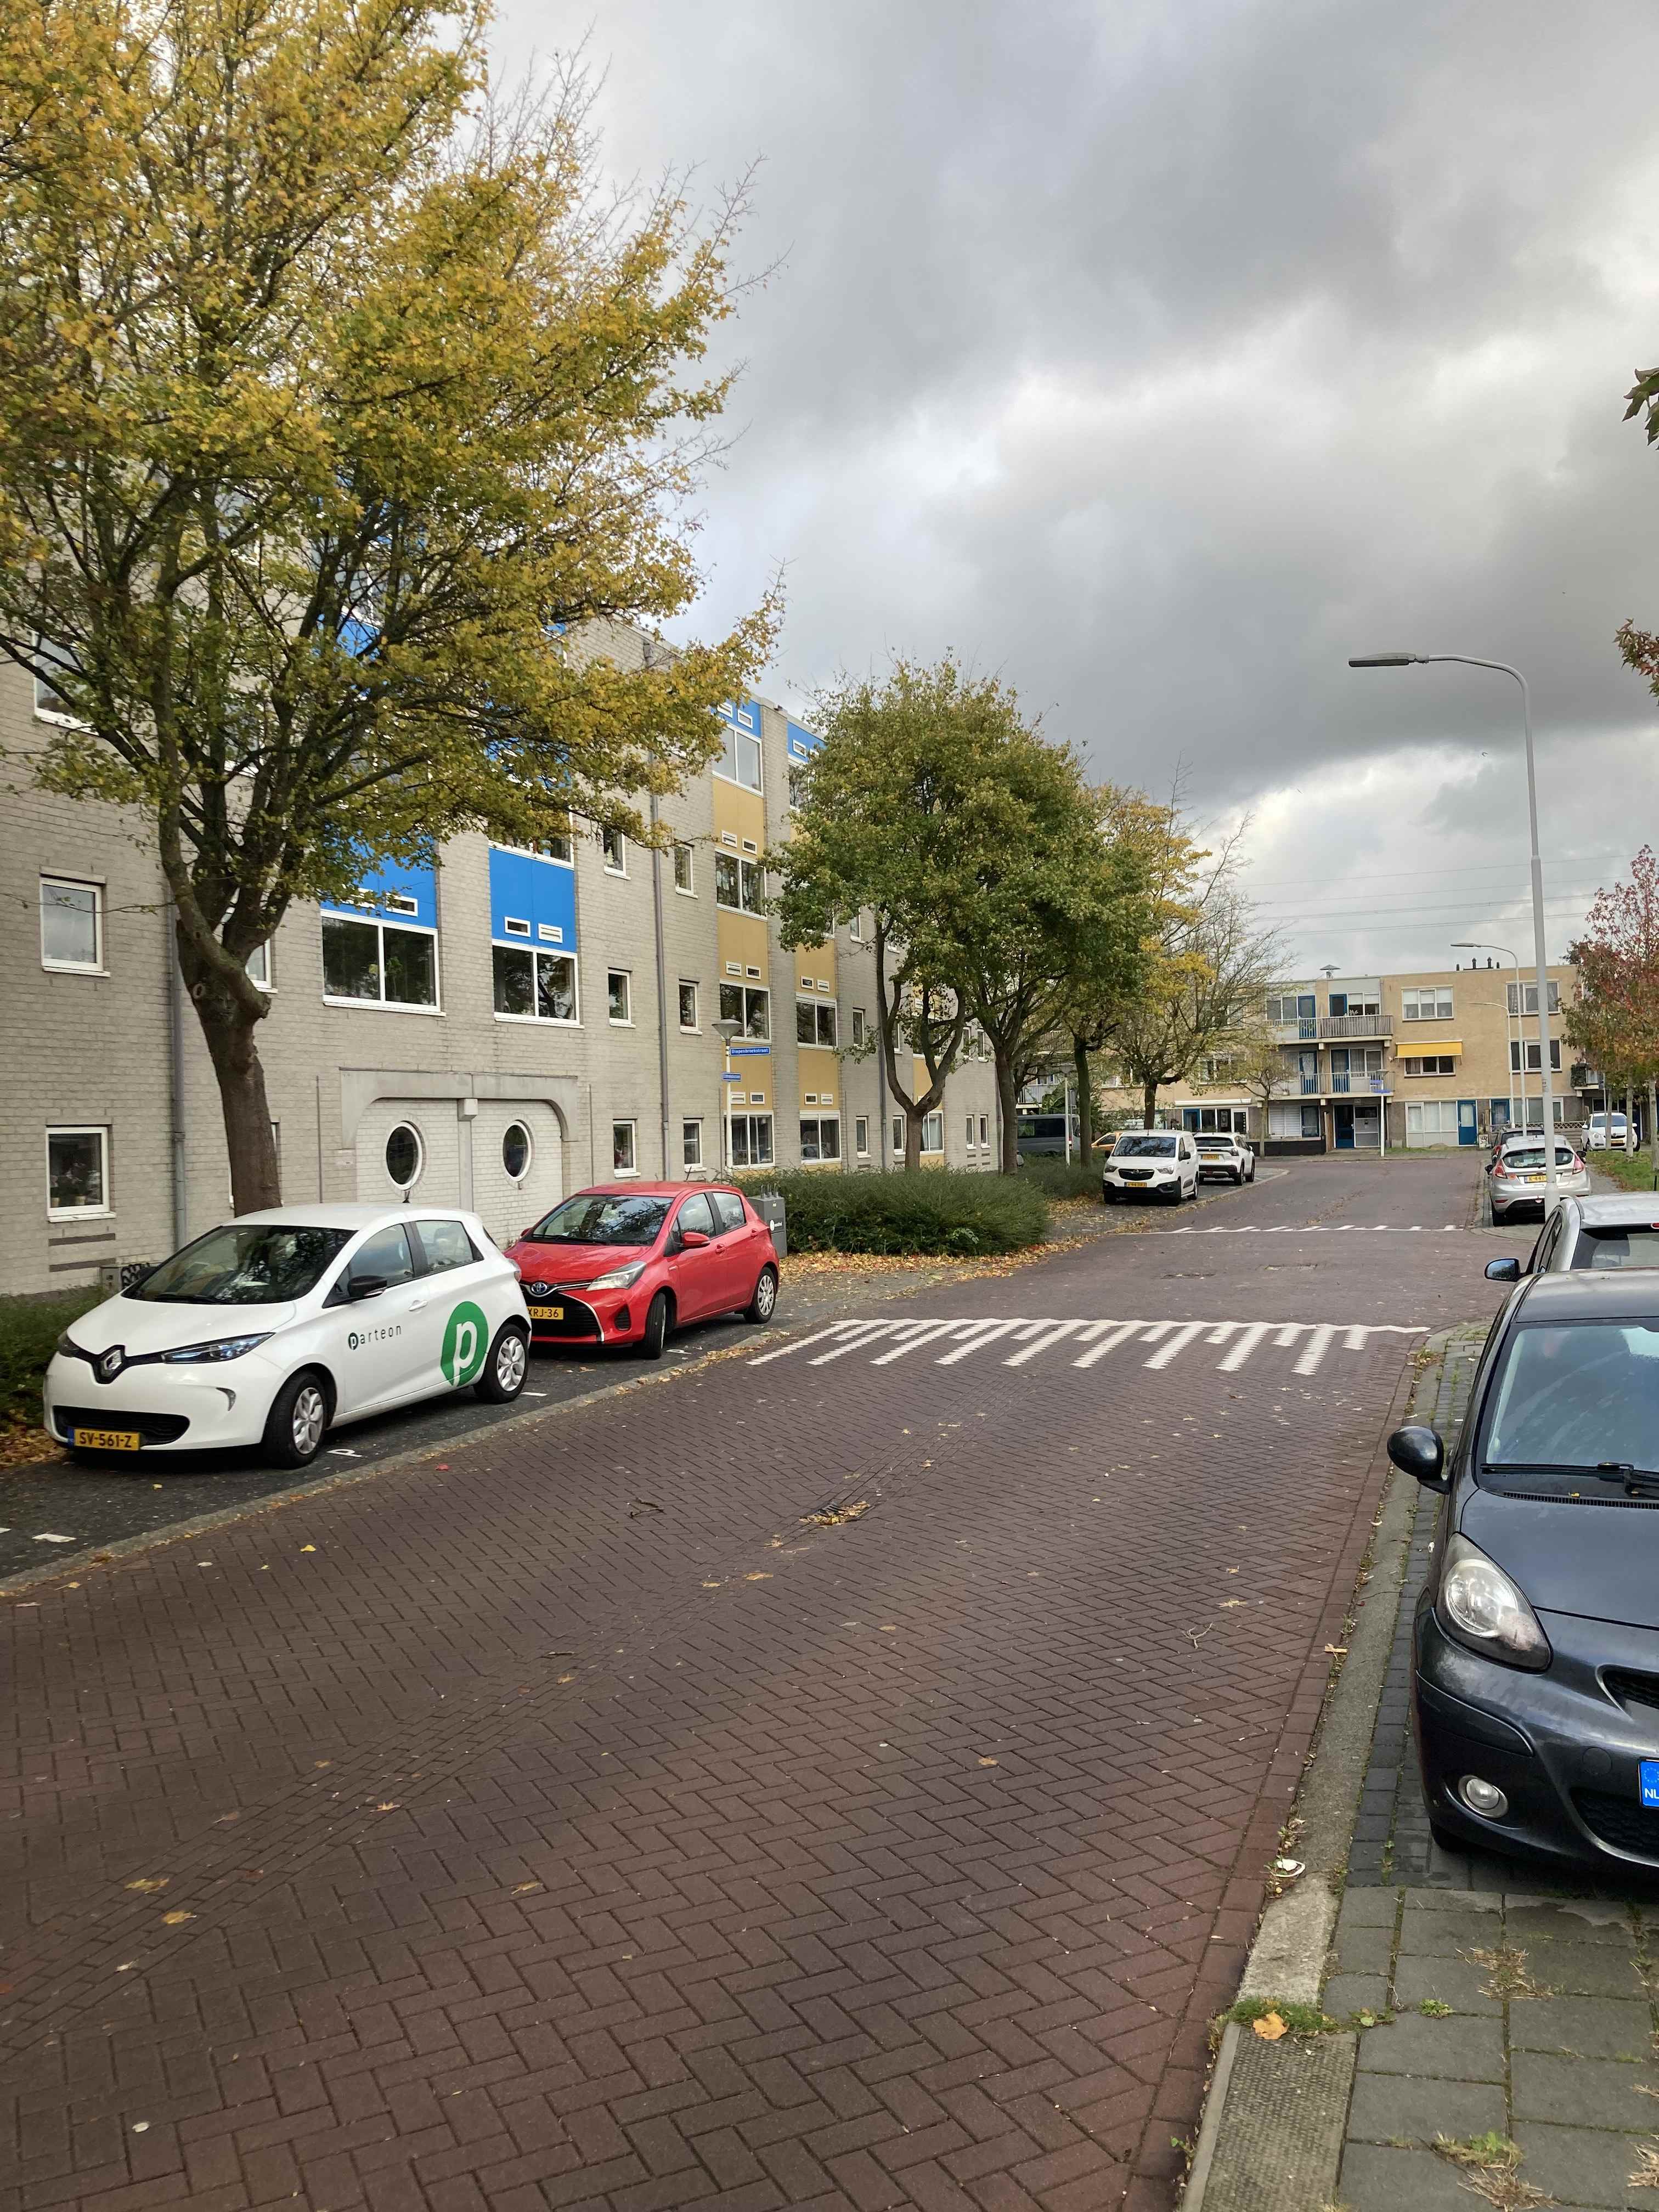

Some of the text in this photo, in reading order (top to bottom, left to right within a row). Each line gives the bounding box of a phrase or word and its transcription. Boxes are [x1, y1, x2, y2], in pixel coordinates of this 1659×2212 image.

[528, 1307, 558, 1318] XRJ-36
[348, 1325, 402, 1350] parteon
[79, 1432, 132, 1448] SV-561-Z
[1645, 1788, 1659, 1799] NL
